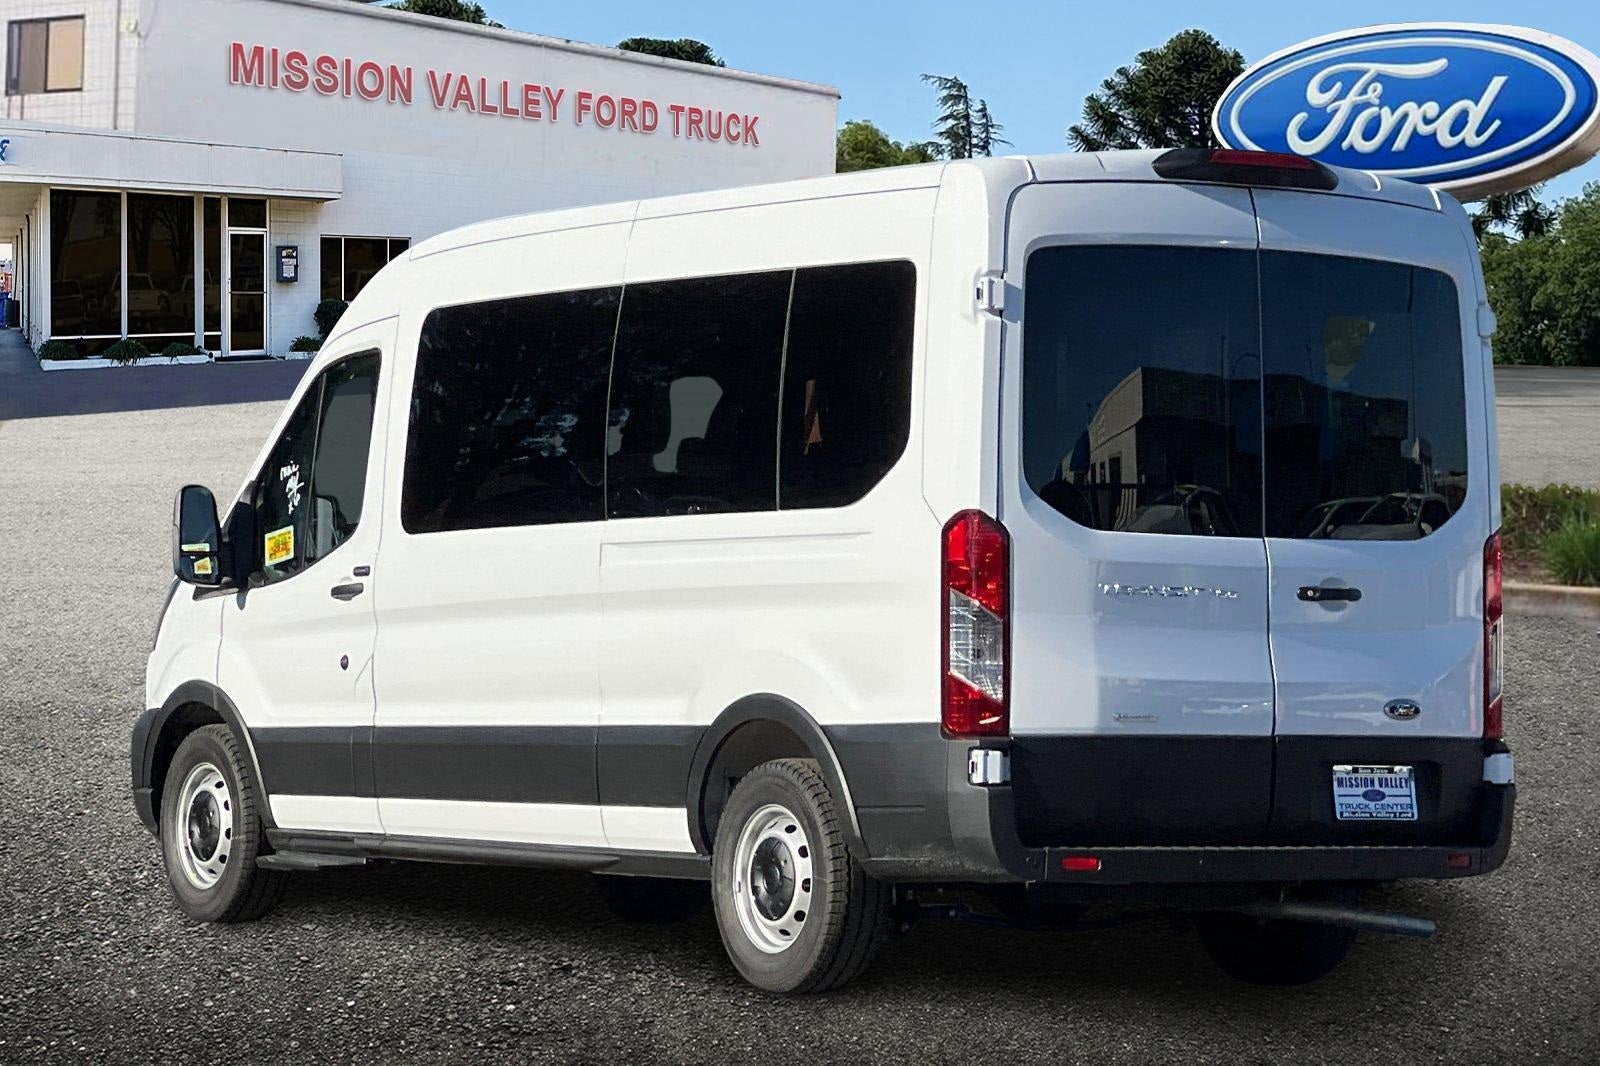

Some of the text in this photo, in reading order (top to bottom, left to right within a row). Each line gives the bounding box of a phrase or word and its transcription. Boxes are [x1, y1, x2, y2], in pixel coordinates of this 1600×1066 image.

[230, 42, 760, 146] MISSION VALLEY FORD TRUCK
[1286, 57, 1509, 156] Ford
[1336, 777, 1409, 789] MISSION VALLEY
[1374, 803, 1413, 811] CENTER
